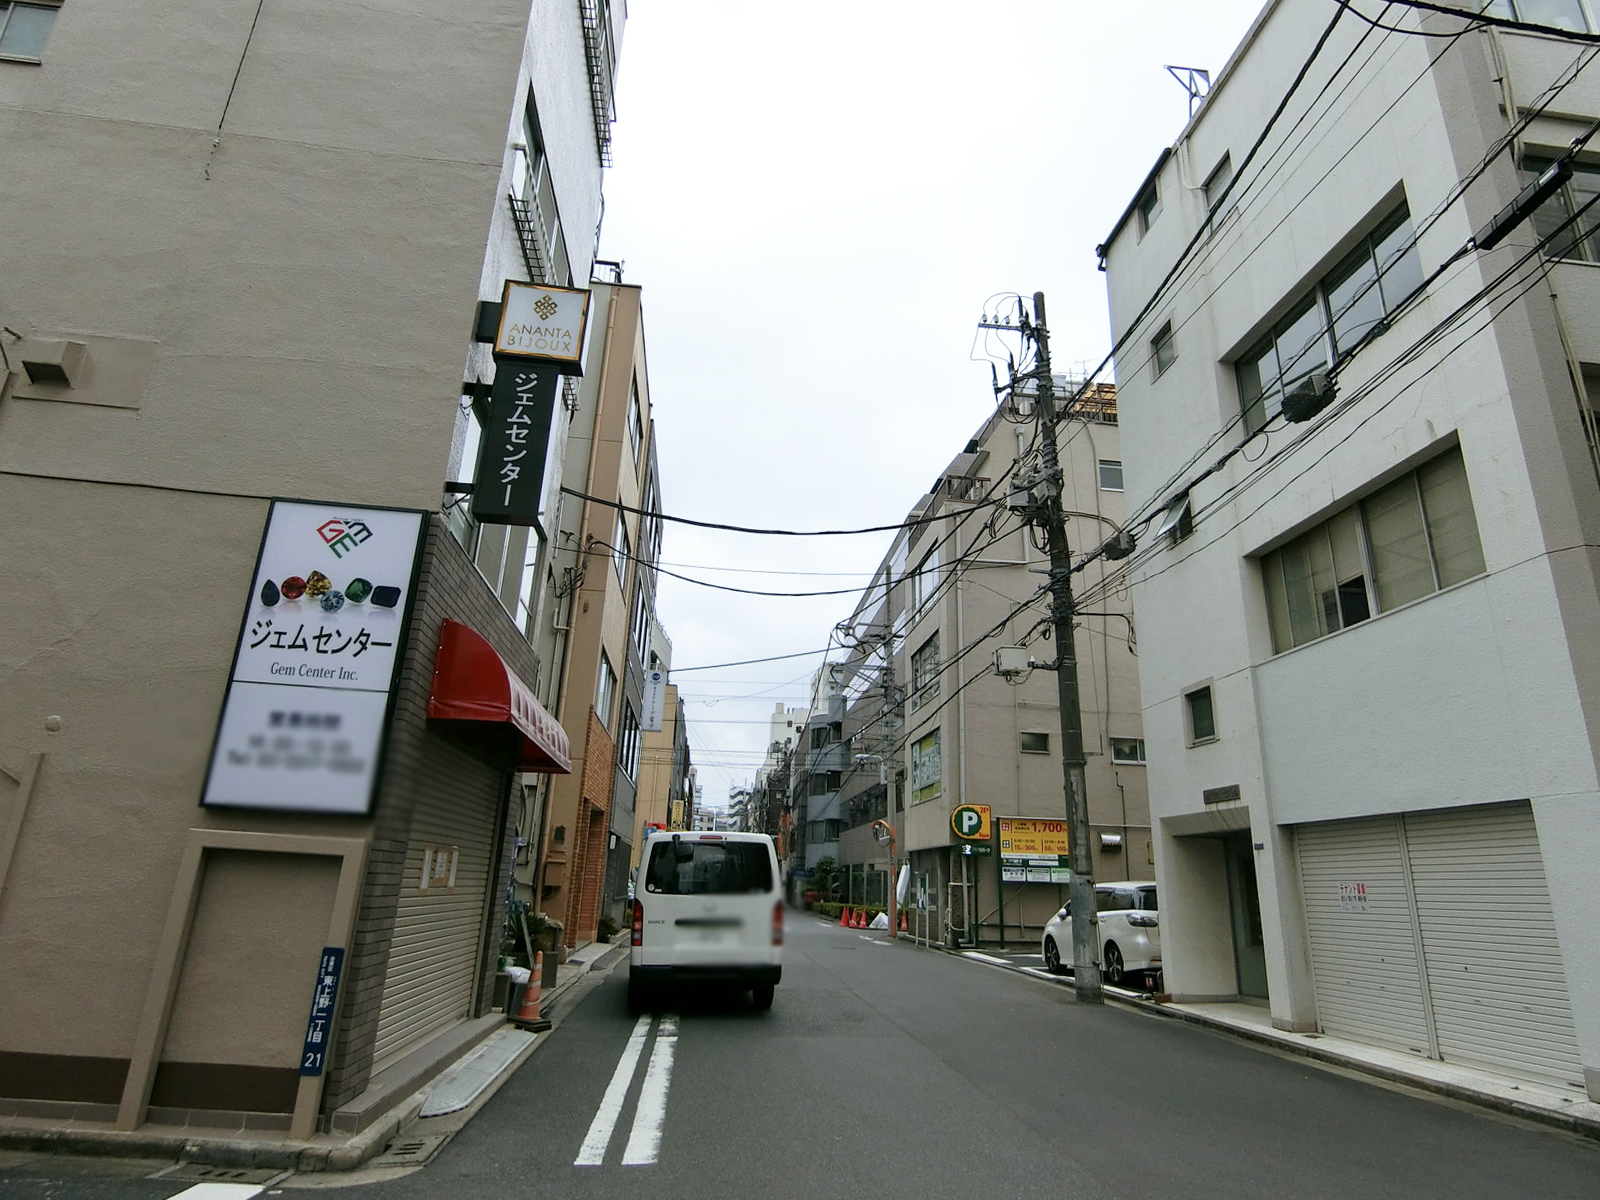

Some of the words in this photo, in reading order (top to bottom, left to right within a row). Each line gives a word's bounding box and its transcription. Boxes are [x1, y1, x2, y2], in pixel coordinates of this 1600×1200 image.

[510, 323, 572, 340] ANANTA
[507, 334, 571, 352] BIJOUX
[500, 372, 538, 506] ジェムセンター
[251, 619, 393, 658] ジェムセンター
[270, 661, 296, 676] Gem
[298, 663, 336, 679] Center
[338, 666, 359, 681] Inc.
[962, 811, 978, 833] P
[312, 975, 333, 1043] 東上野一丁目
[304, 1052, 322, 1068] 21
